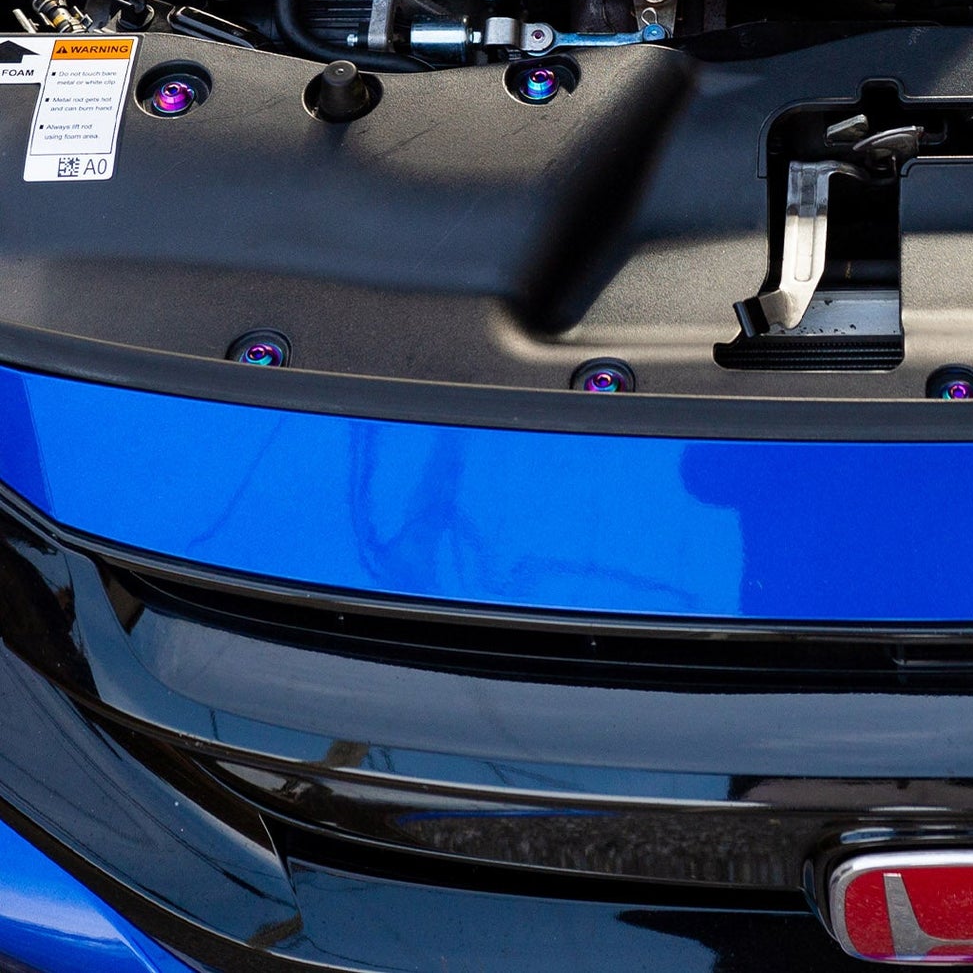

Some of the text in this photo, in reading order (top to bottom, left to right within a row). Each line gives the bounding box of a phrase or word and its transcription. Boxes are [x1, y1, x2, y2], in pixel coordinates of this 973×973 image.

[70, 45, 129, 54] WARNING
[1, 69, 35, 77] FOAM
[46, 123, 71, 131] Always
[83, 158, 108, 176] A0
